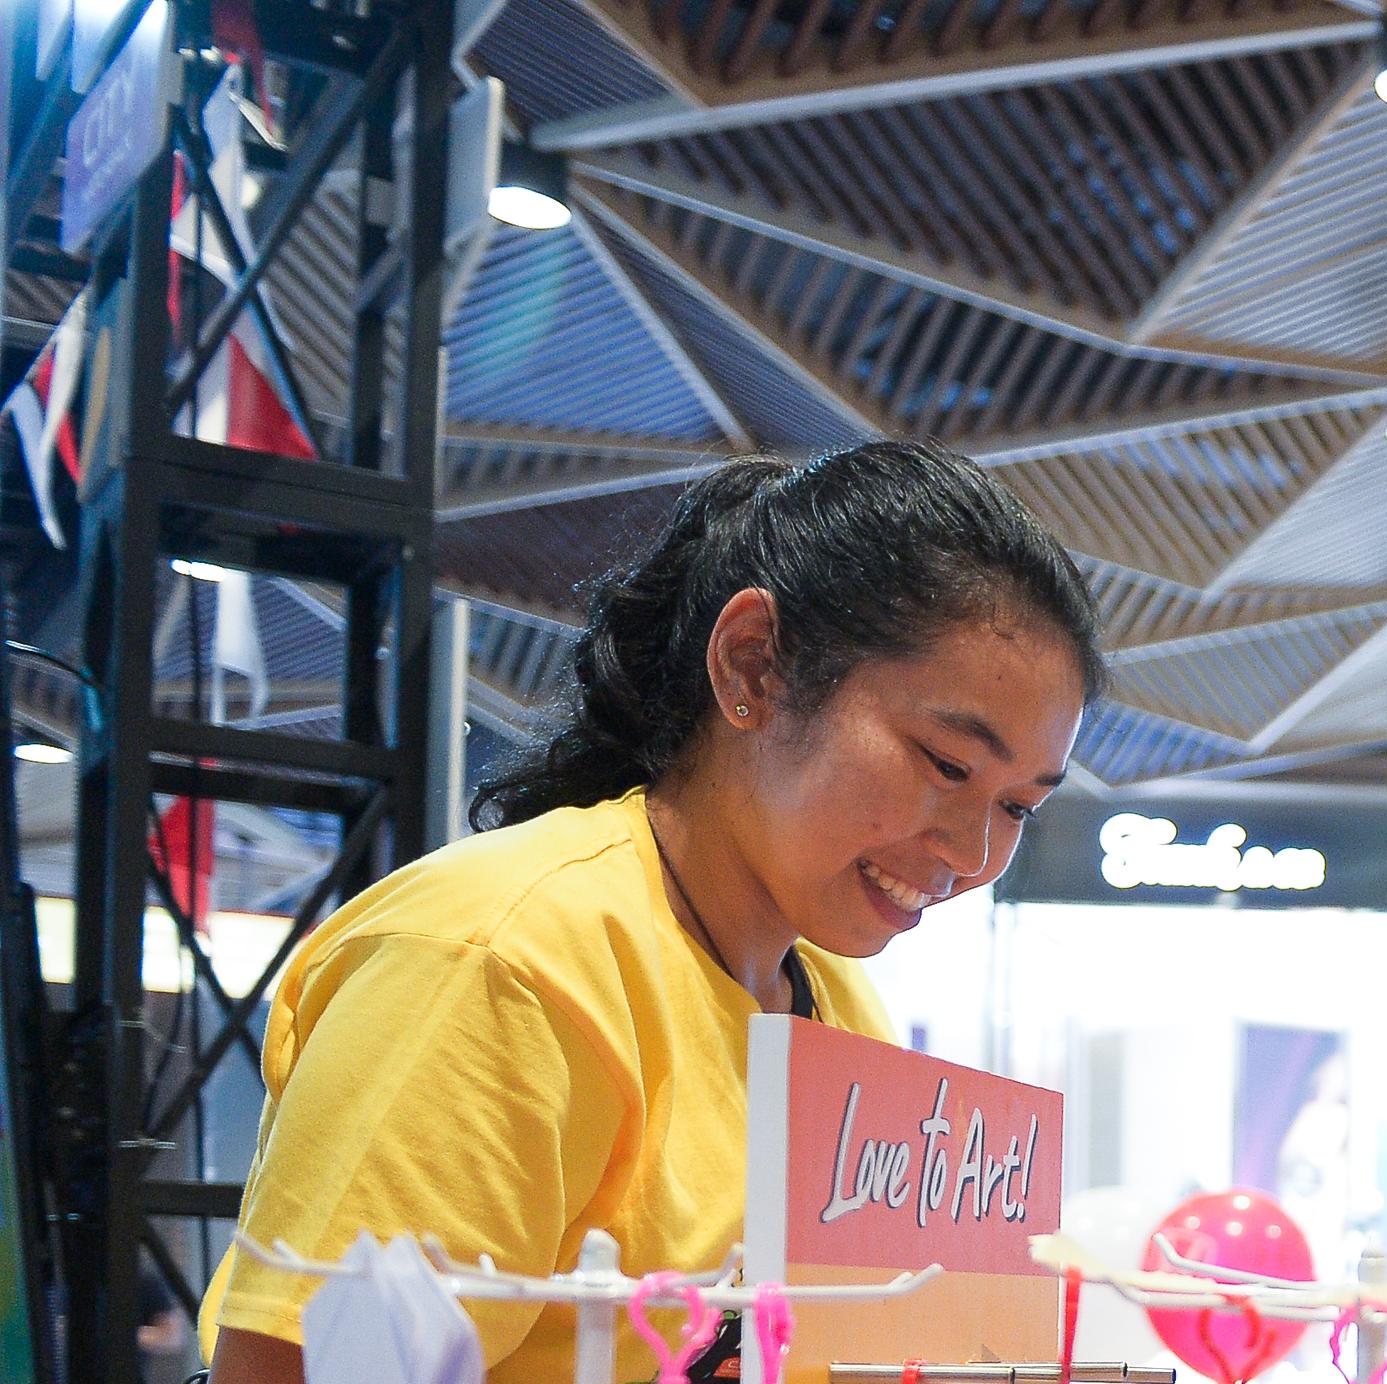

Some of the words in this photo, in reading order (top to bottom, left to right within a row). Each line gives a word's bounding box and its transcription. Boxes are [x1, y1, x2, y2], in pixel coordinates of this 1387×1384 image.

[819, 1081, 911, 1223] Love
[917, 1077, 951, 1228] To
[951, 1107, 1038, 1223] Art!
